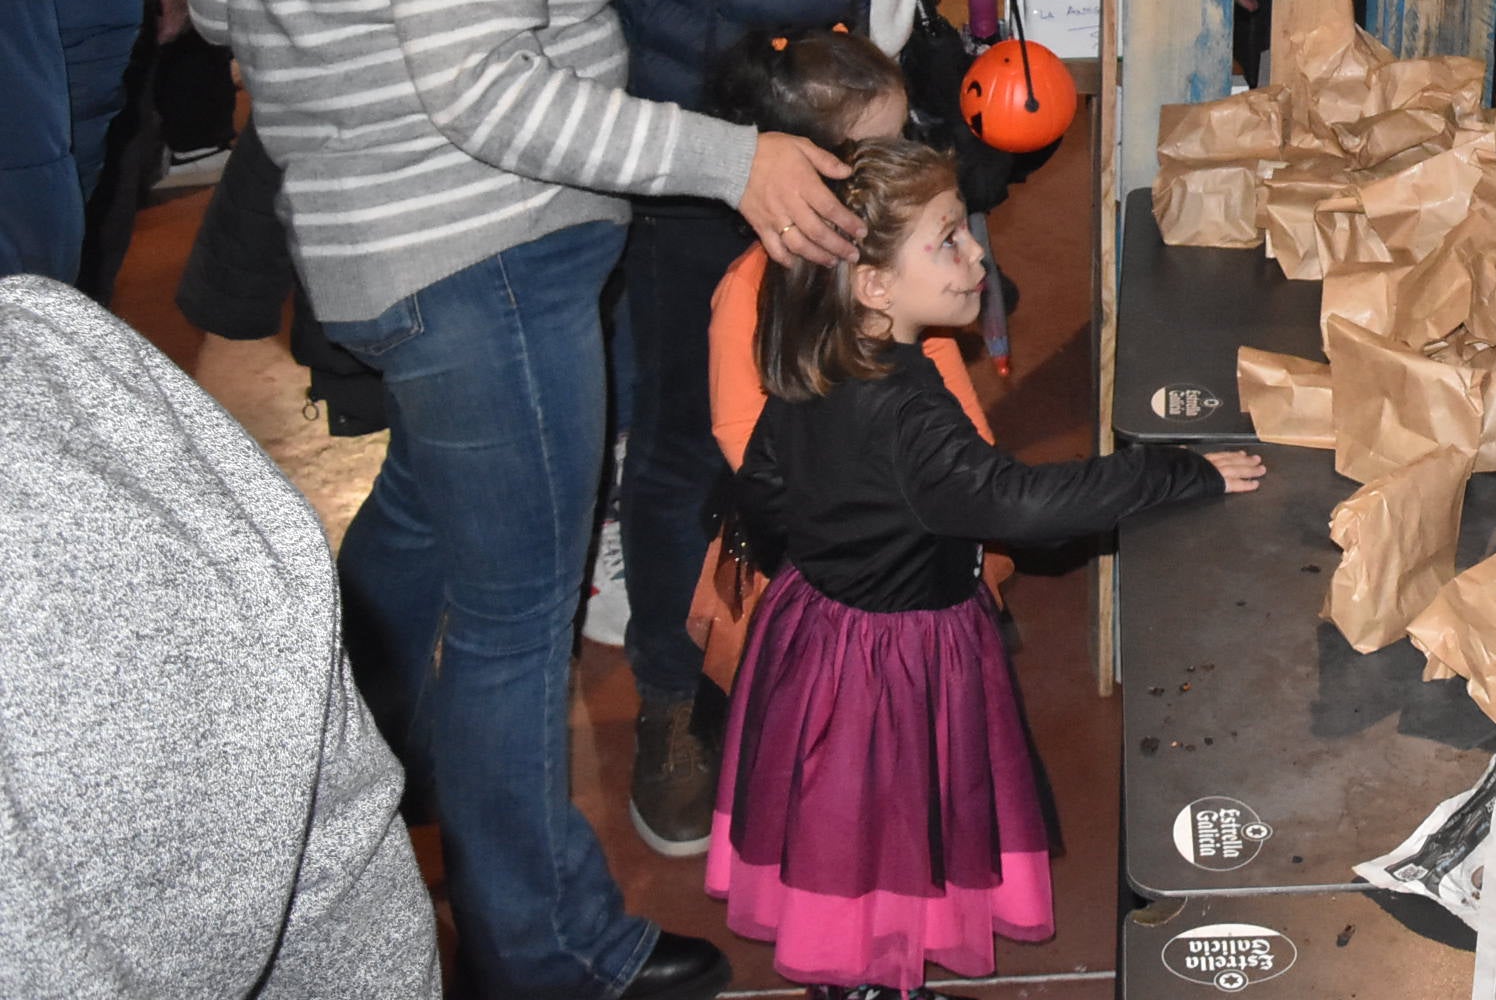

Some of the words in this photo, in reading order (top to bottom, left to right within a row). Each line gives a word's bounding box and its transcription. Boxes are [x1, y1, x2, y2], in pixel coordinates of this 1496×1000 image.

[1196, 809, 1221, 857] Galicia
[1219, 808, 1244, 858] Estrella
[1184, 954, 1275, 972] Estrella
[1188, 938, 1271, 956] Galicia
